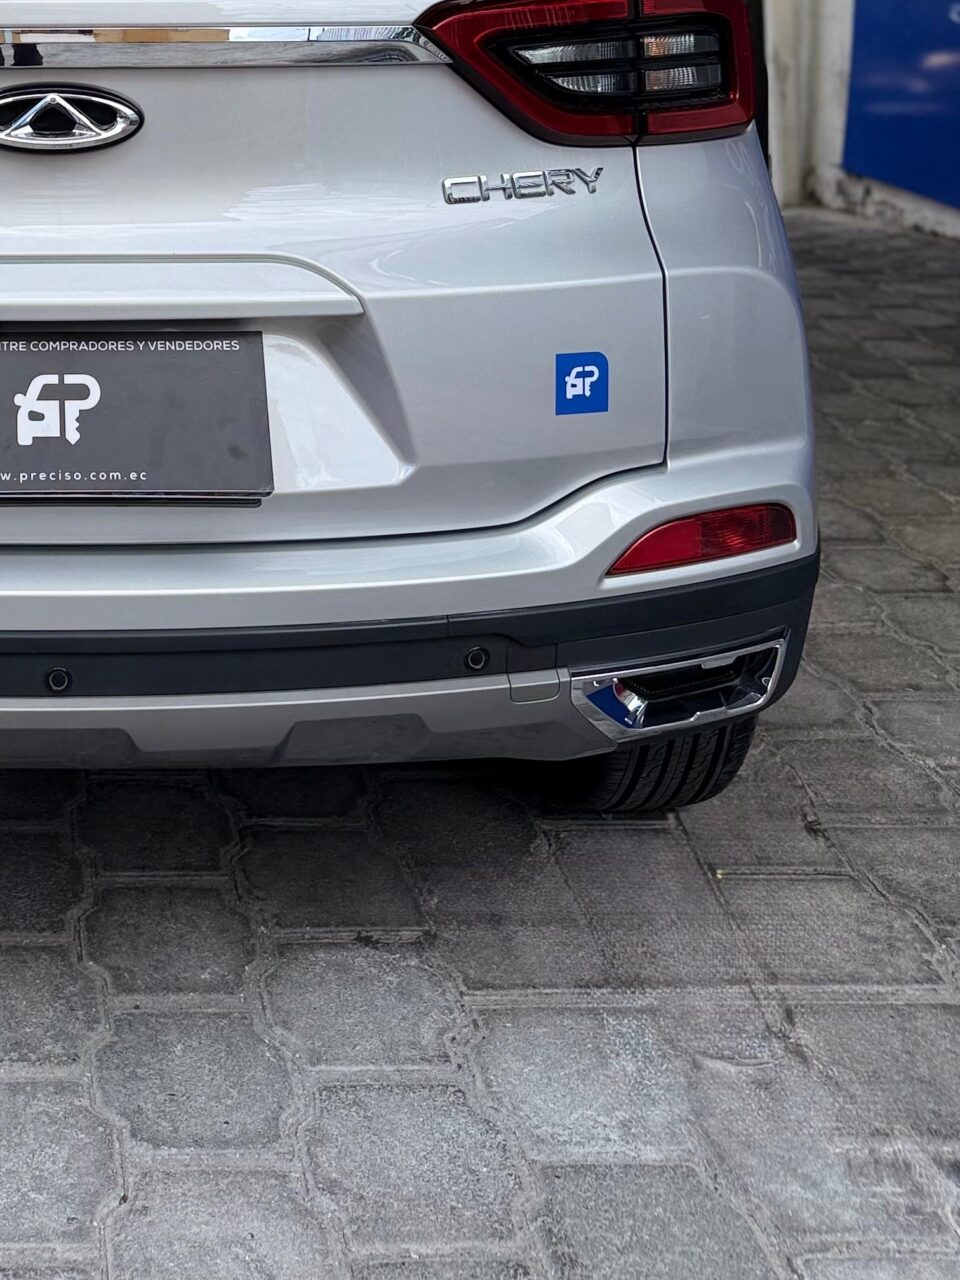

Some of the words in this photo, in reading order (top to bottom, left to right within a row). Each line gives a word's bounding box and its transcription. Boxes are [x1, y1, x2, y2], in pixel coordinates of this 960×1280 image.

[442, 167, 603, 205] CHERY
[30, 340, 135, 352] COMPRADORES
[136, 340, 146, 351] Y
[148, 340, 240, 351] VENDEDORES
